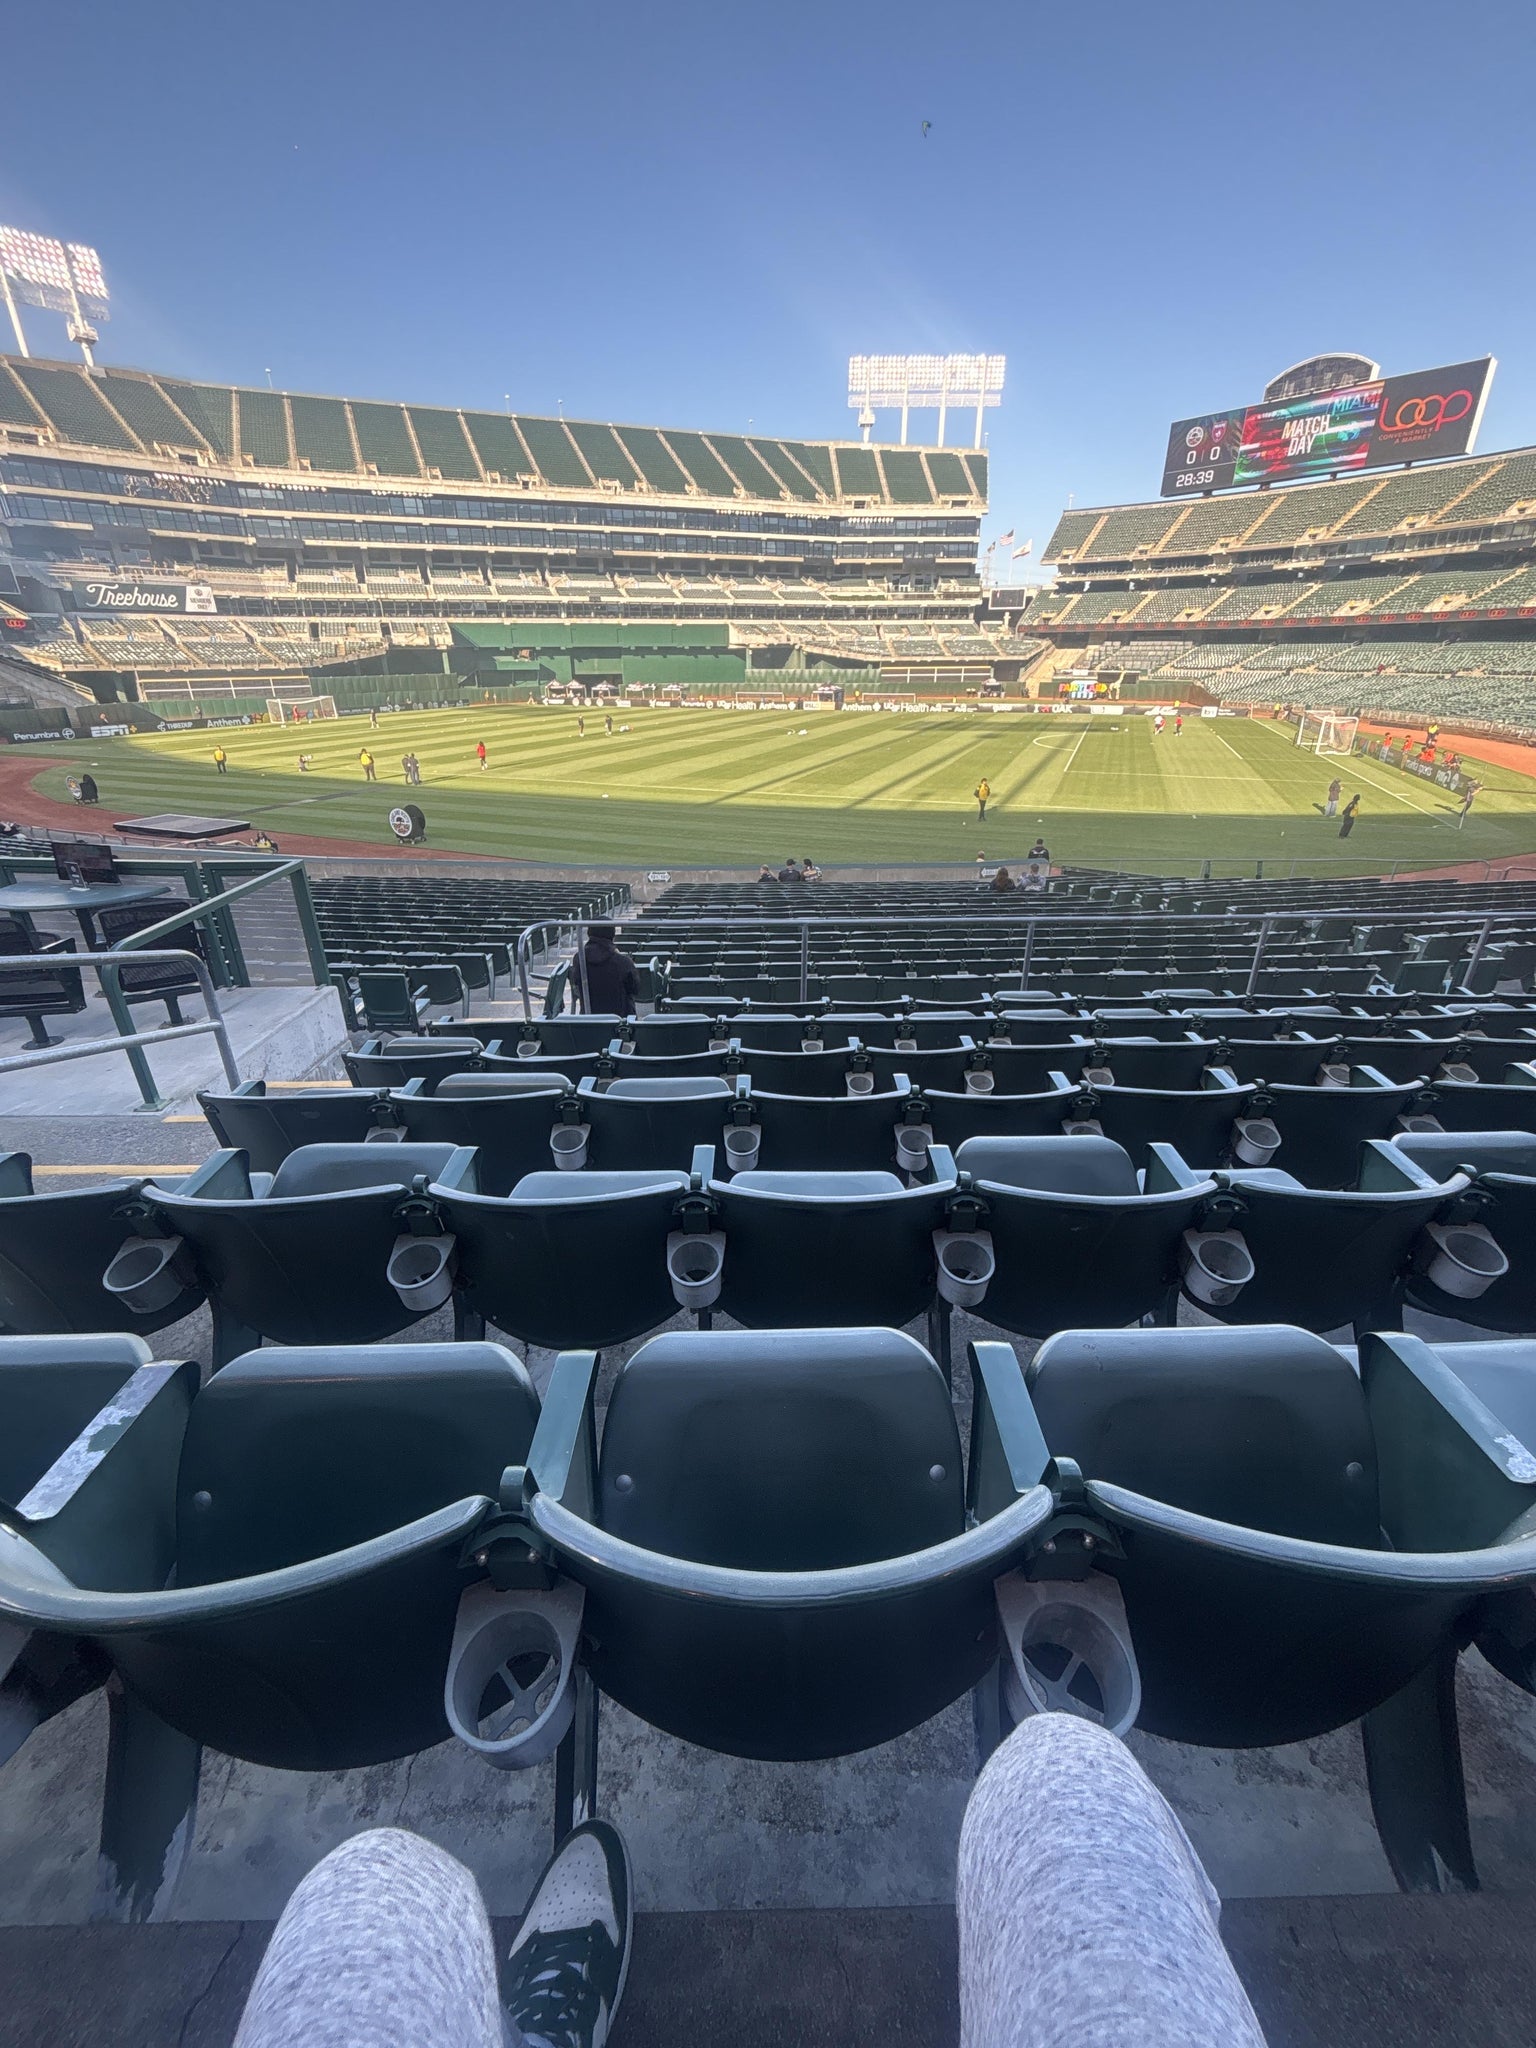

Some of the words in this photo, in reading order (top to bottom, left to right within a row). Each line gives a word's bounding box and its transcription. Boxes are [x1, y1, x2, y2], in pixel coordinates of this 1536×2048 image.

[1281, 414, 1331, 439] MATCH
[1379, 427, 1434, 441] CONVENIENTLY
[1401, 434, 1432, 444] MARKET
[1287, 433, 1316, 456] DAY
[1186, 450, 1197, 464] 0
[1209, 446, 1220, 461] 0
[1175, 470, 1214, 487] 28:39
[85, 583, 179, 608] Treehouse
[732, 700, 757, 710] Health
[759, 701, 788, 711] Anthem
[841, 702, 872, 712] Anthem
[901, 702, 929, 713] Health
[1052, 704, 1073, 713] OAK
[166, 721, 194, 730] THREDUP
[207, 718, 242, 729] Anthem
[13, 731, 61, 741] Penumbra
